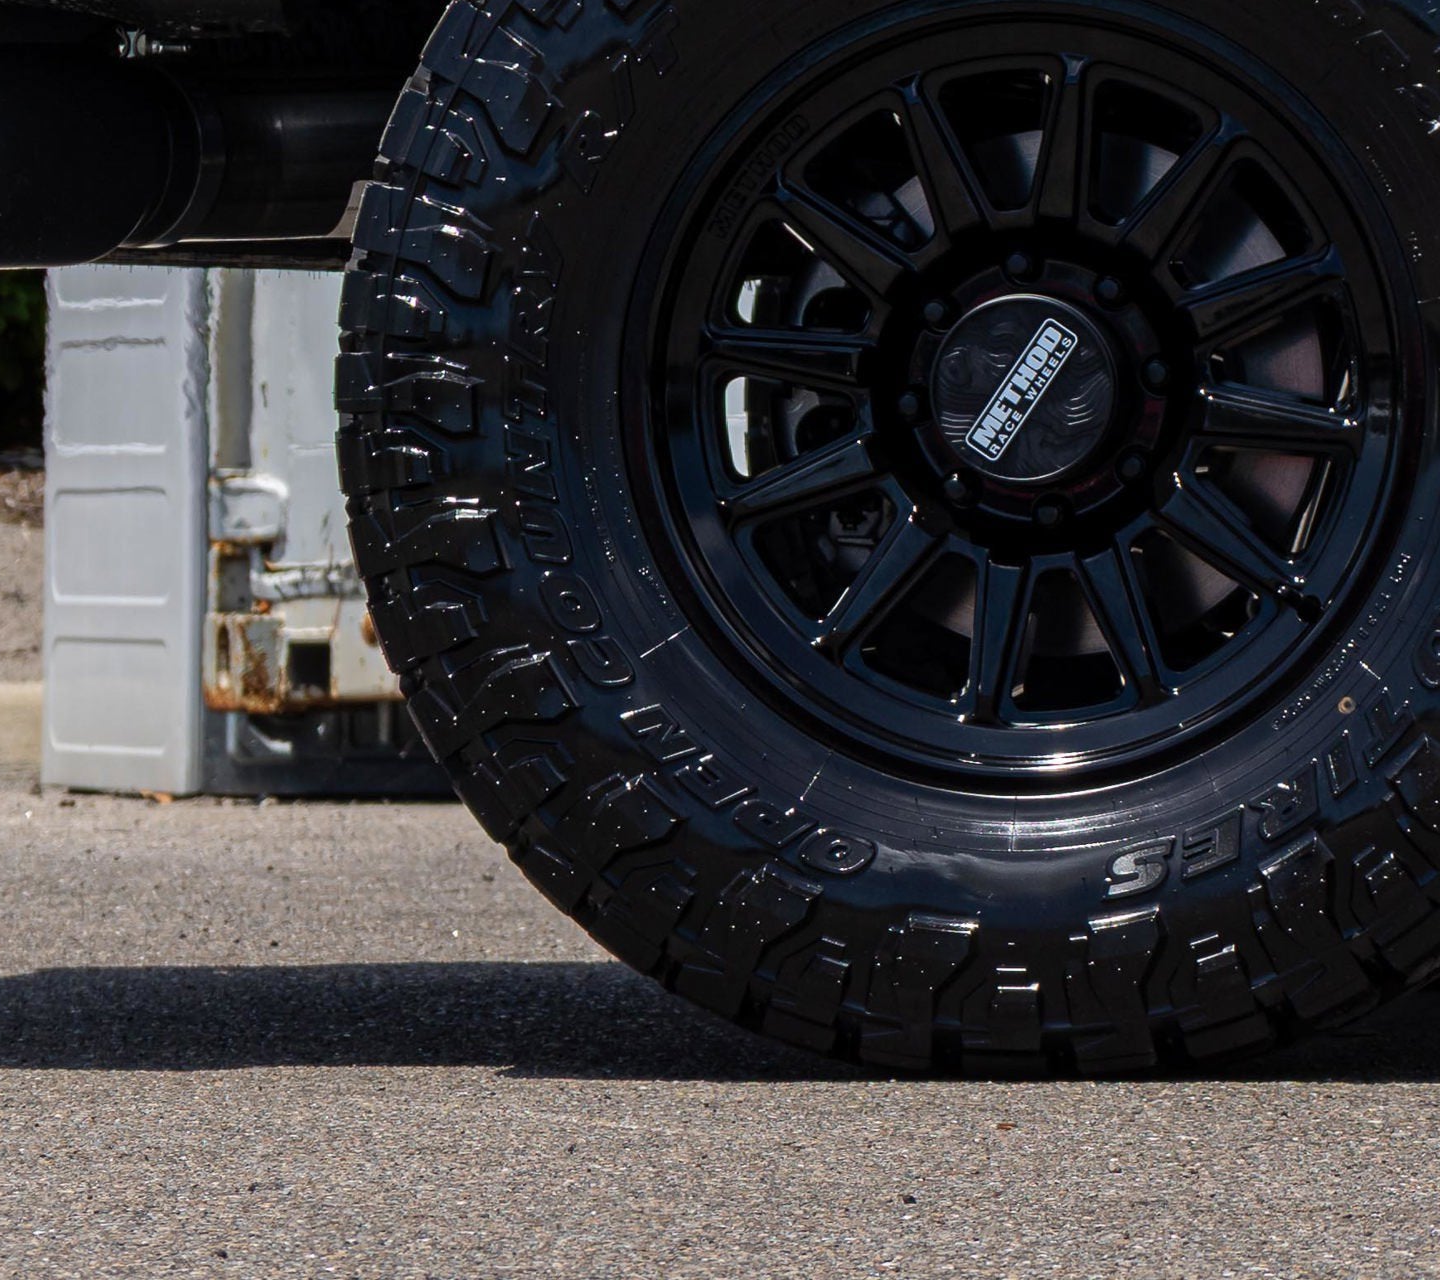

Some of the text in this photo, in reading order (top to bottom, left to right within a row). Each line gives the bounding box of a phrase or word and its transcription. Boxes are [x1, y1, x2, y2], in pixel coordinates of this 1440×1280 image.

[706, 113, 812, 239] METHOD
[503, 4, 878, 876] OPEN COUNTRY R/T
[972, 326, 1062, 449] METHOD
[989, 337, 1072, 455] RACE WHEELS
[1101, 688, 1414, 900] TIRES
